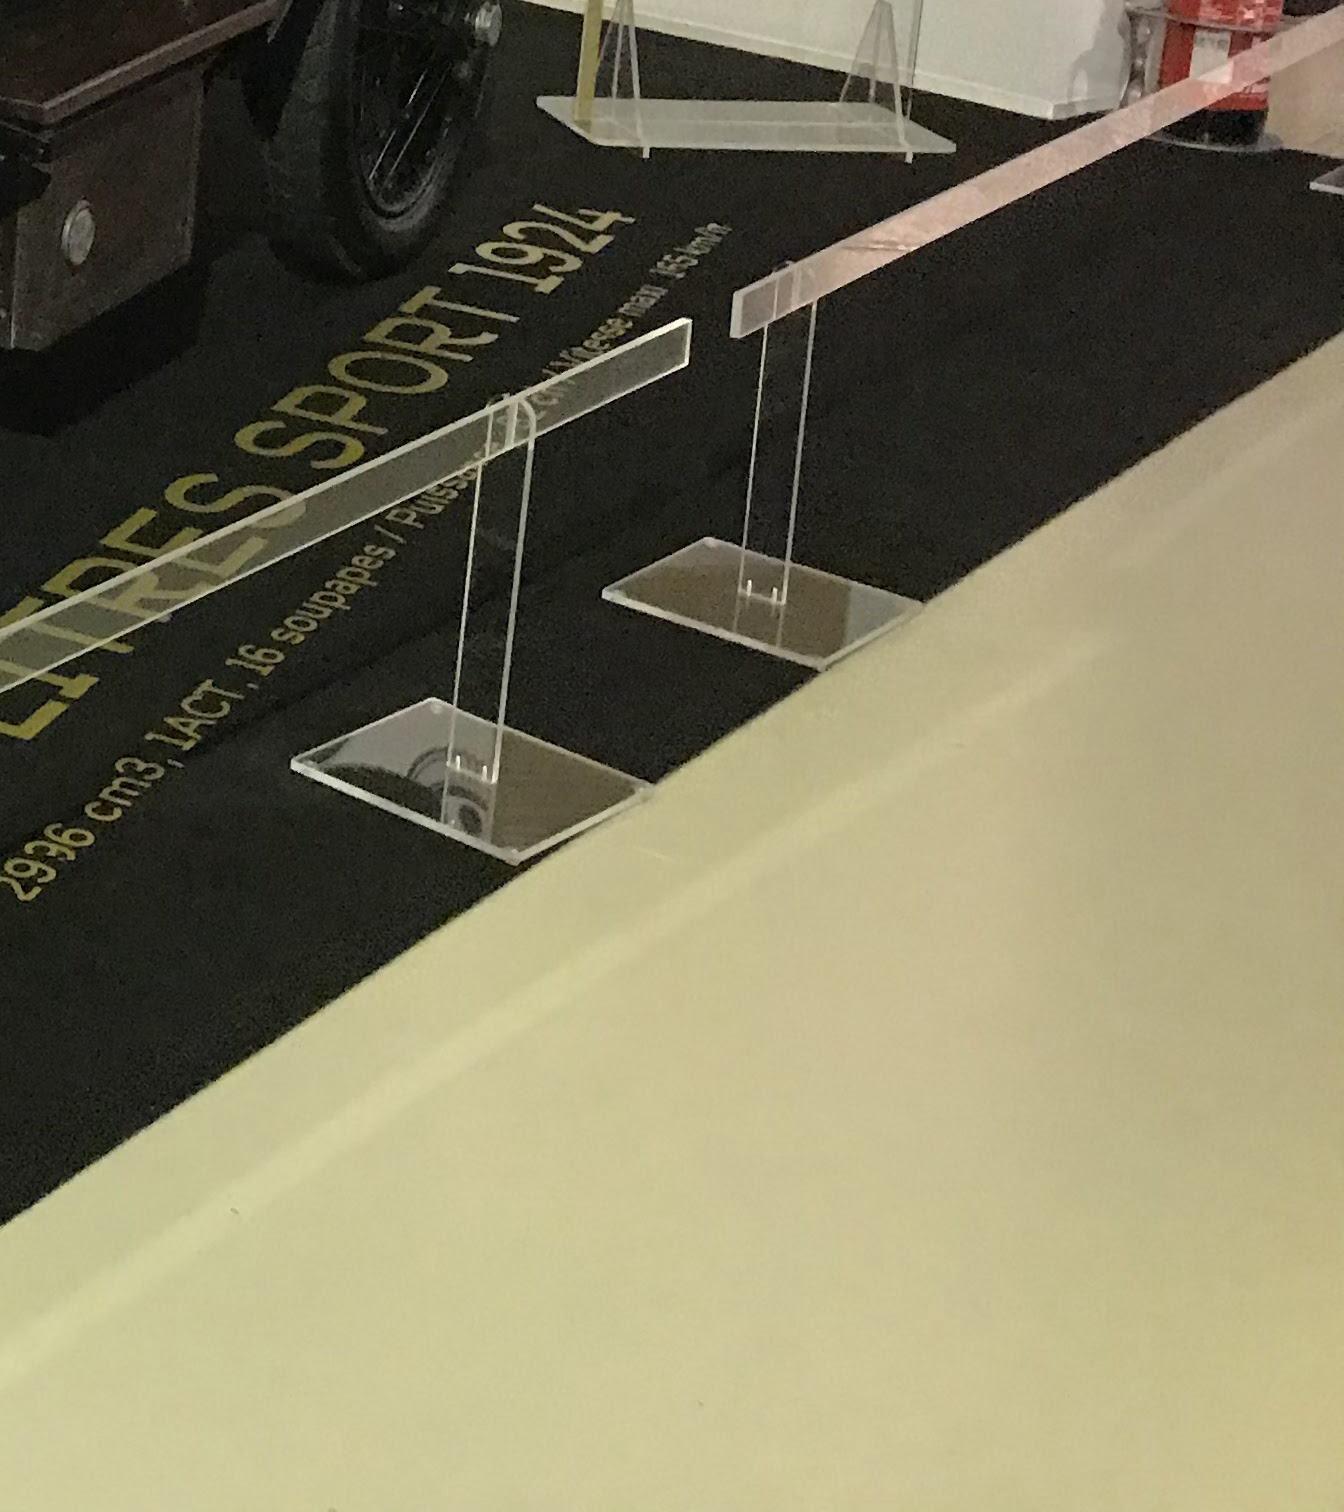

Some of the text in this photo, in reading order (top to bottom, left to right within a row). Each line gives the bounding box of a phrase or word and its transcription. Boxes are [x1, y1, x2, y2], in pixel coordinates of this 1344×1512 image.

[234, 286, 521, 470] SPORT
[447, 203, 636, 295] 1924
[224, 644, 286, 677] 16
[270, 542, 396, 646] soupapes
